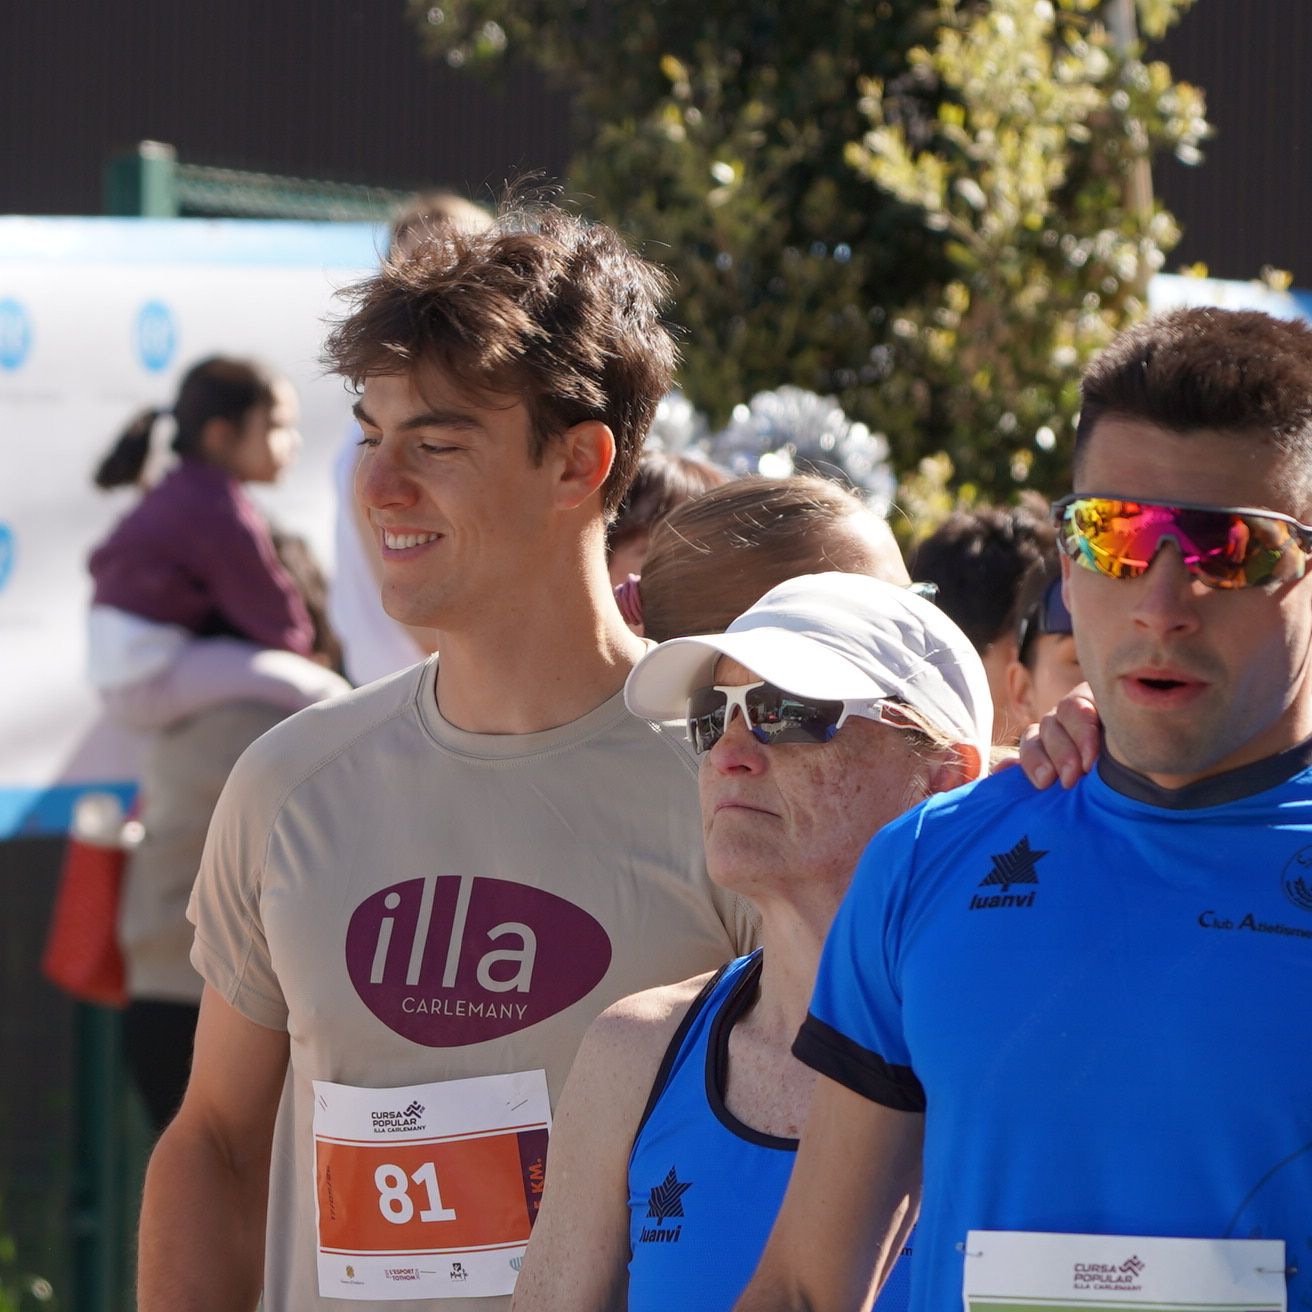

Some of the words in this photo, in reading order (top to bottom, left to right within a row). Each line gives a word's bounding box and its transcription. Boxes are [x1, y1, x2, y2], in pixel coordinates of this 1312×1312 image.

[969, 891, 1037, 911] luanvi
[1198, 910, 1234, 929] Club
[1239, 912, 1312, 939] Atletisme
[370, 876, 537, 993] illa
[402, 997, 528, 1020] CARLEMANY
[371, 1111, 403, 1120] CURSA
[372, 1118, 417, 1127] POPULAR
[374, 1162, 457, 1225] 81
[639, 1225, 682, 1243] luanvi
[1074, 1263, 1117, 1273] CURSA
[1074, 1274, 1132, 1283] POPULAR
